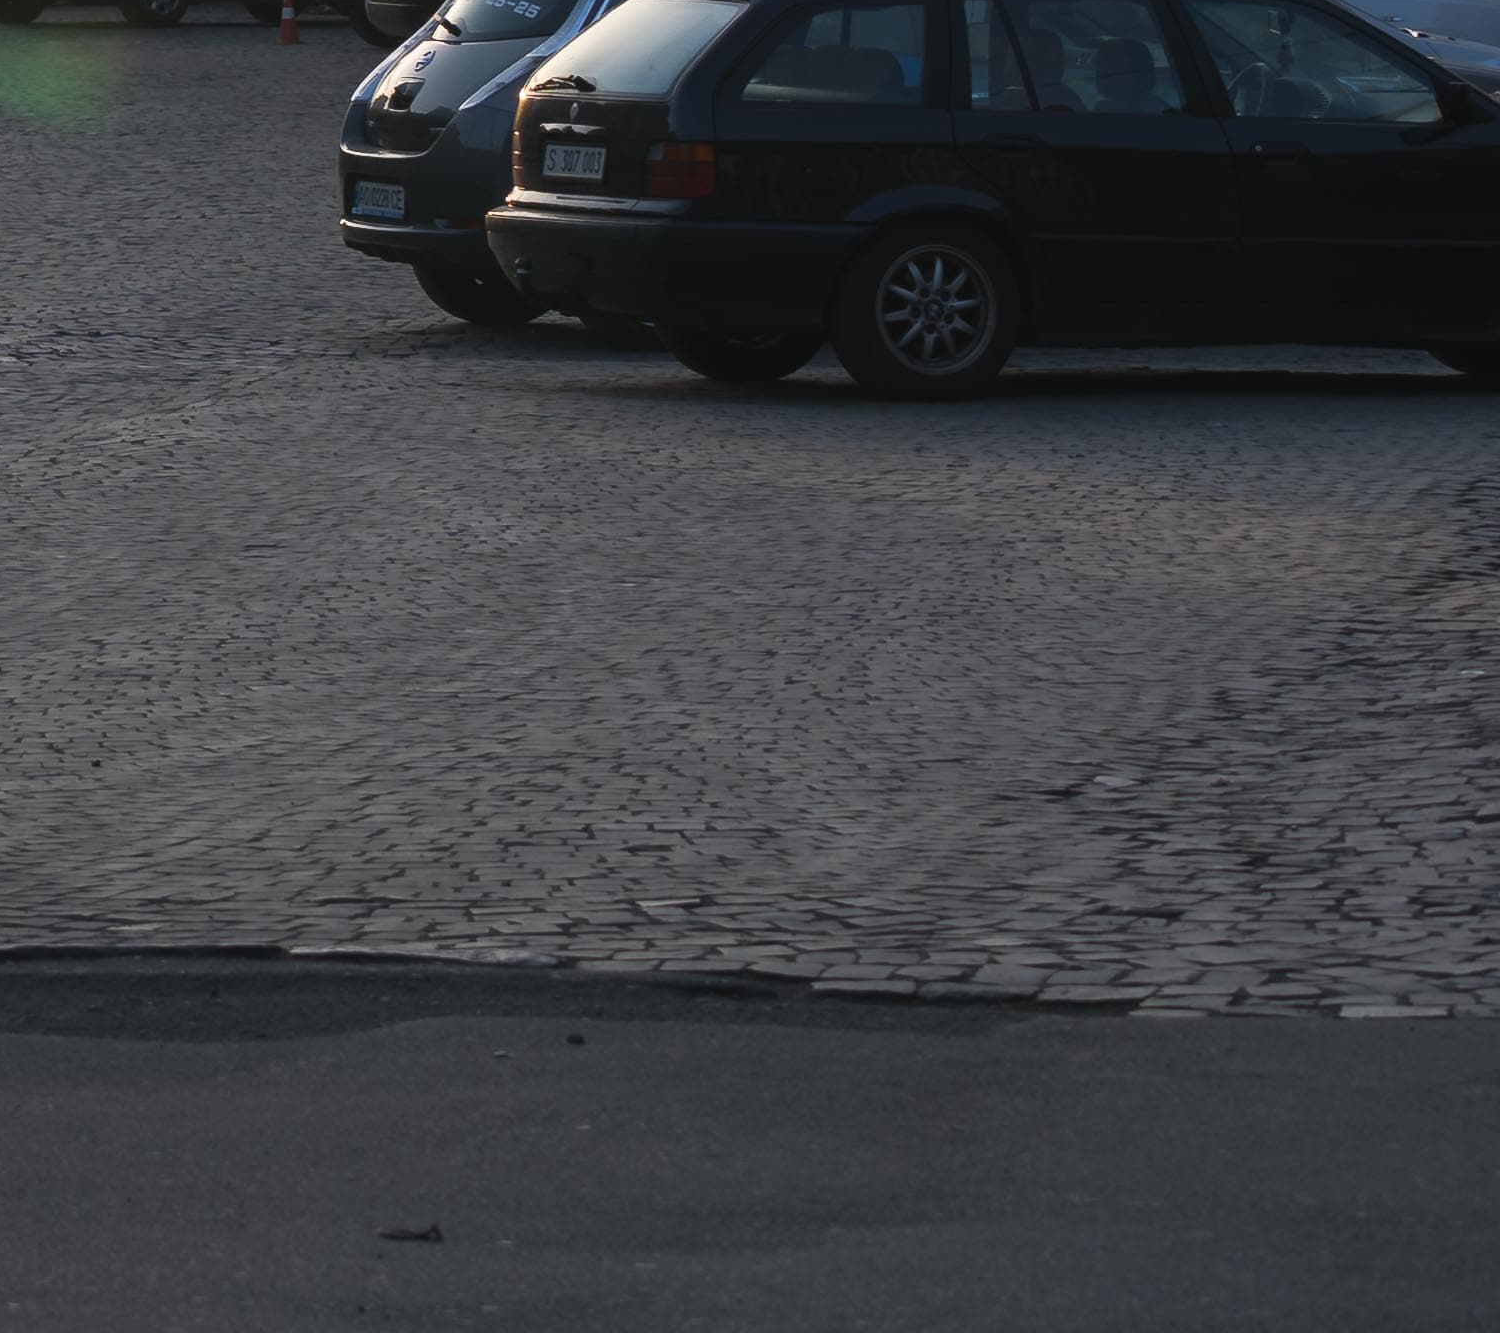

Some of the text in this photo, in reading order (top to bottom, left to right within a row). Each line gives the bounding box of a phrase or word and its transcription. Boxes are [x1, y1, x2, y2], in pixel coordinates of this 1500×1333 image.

[547, 149, 602, 173] S 307 003
